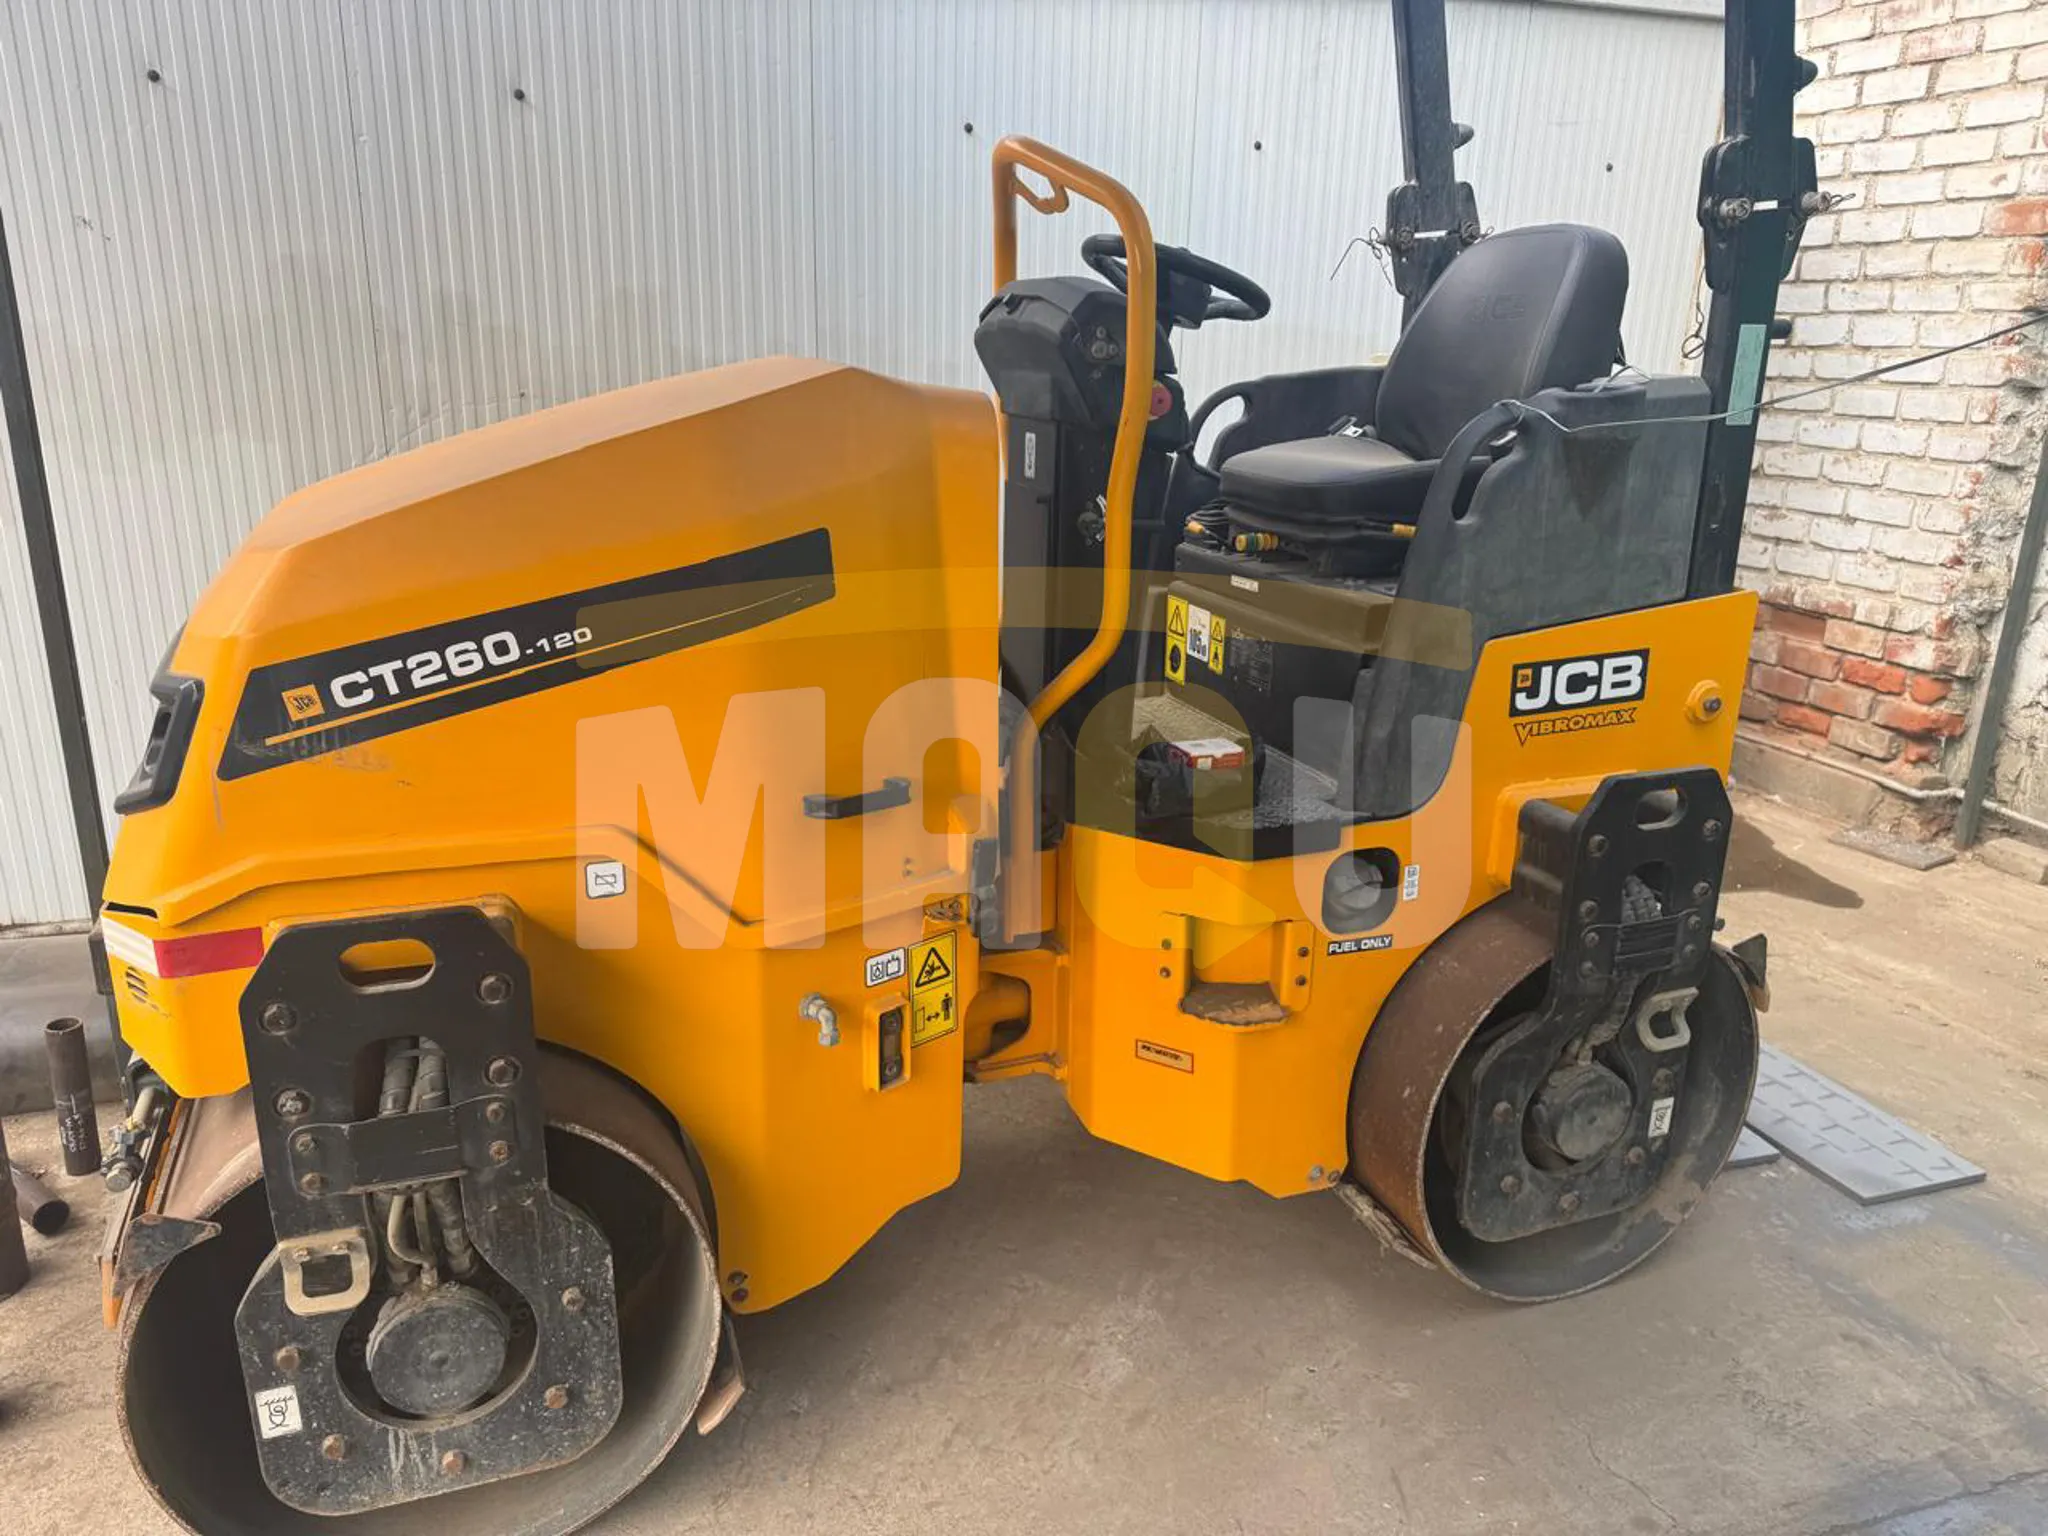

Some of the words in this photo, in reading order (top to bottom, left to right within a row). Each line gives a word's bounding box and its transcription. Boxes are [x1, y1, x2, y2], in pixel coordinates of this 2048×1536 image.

[1515, 655, 1644, 711] JCB
[1514, 707, 1638, 747] VIBROMAX
[1328, 941, 1358, 954] FUEL
[1361, 936, 1391, 950] ONLY
